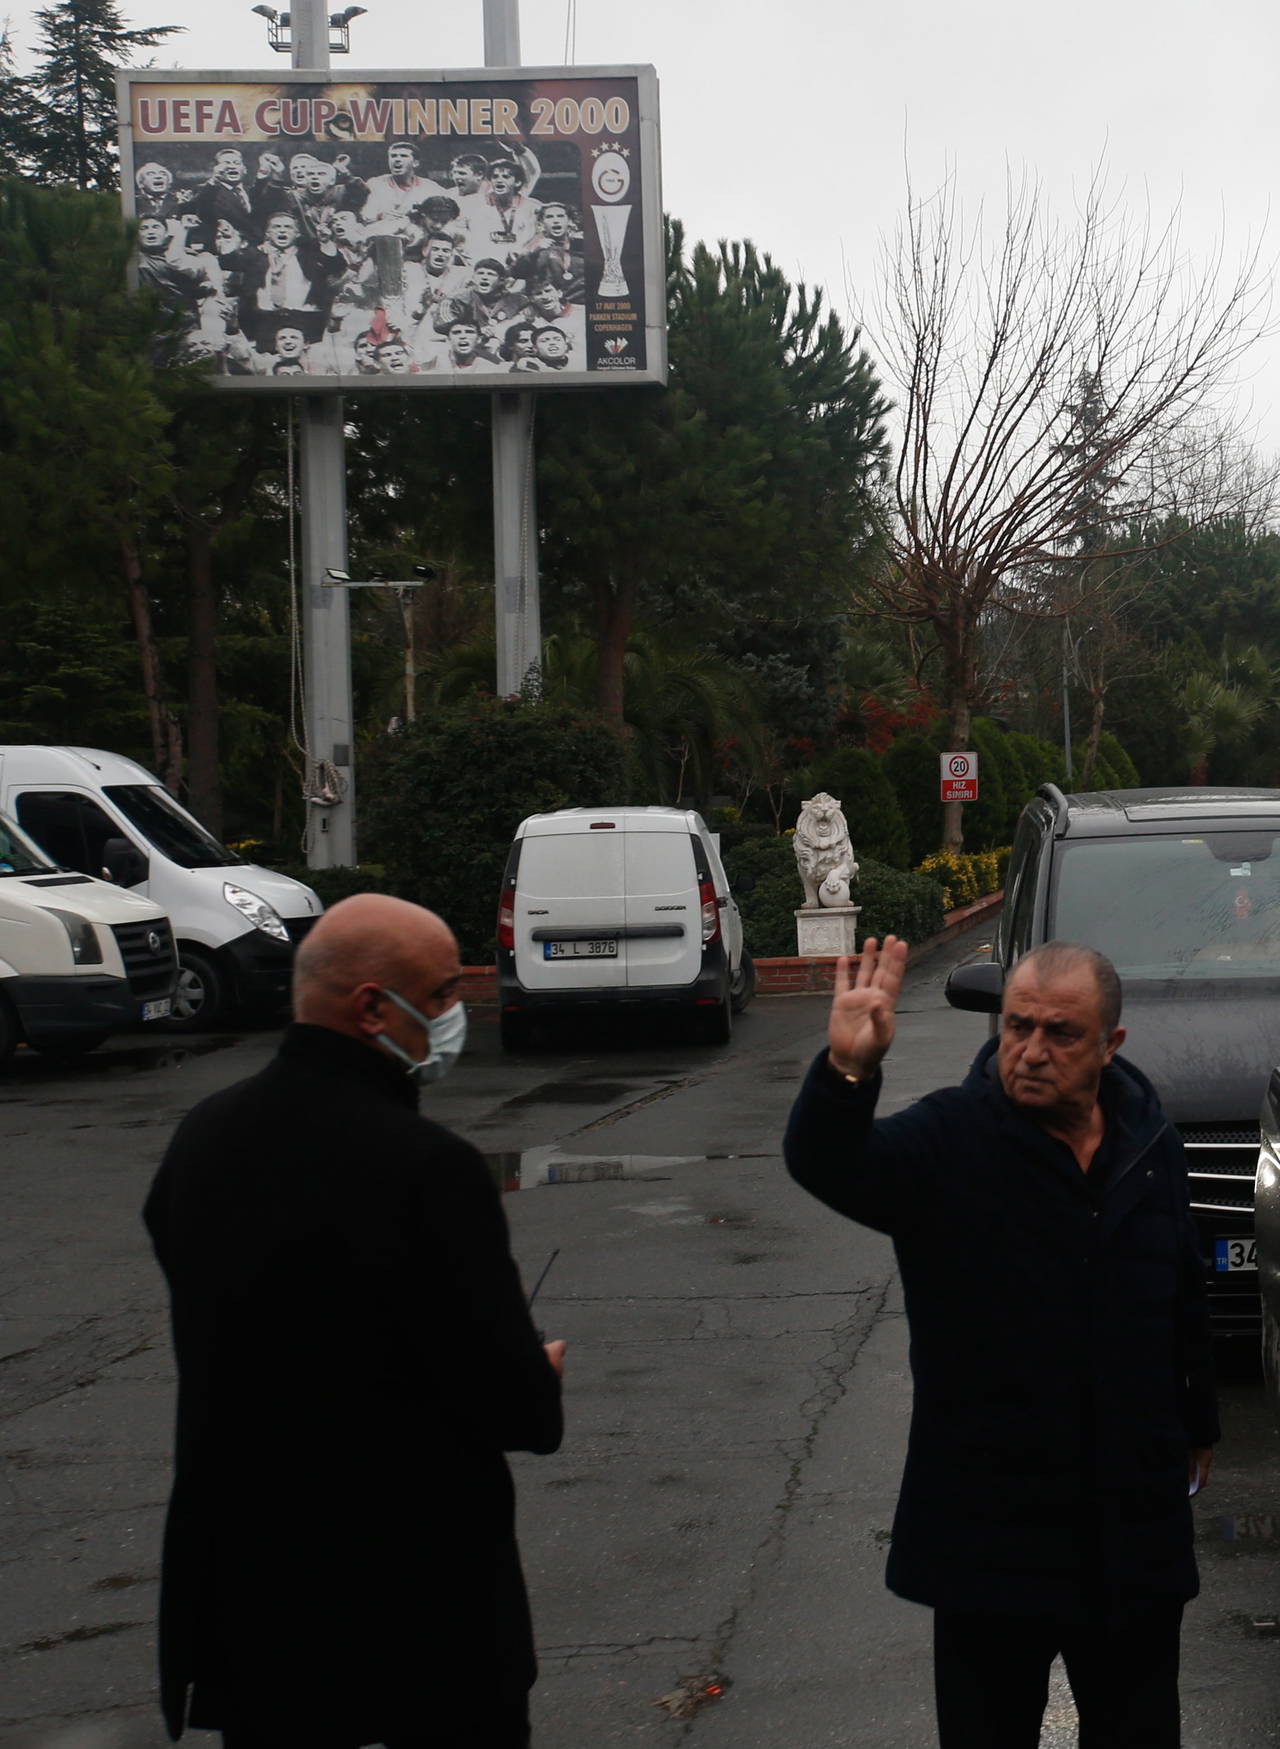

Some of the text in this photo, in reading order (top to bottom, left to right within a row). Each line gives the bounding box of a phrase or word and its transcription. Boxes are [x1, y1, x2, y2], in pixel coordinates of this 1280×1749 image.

[138, 97, 630, 135] UEFA CUP WINNER 2000
[594, 323, 633, 331] COPENHAGEN
[597, 356, 636, 365] AKCOLOR
[953, 761, 966, 772] 20
[952, 781, 967, 790] HIZ
[552, 941, 615, 955] 34 L 3876
[1230, 1242, 1258, 1268] 34
[1216, 1257, 1228, 1265] TR
